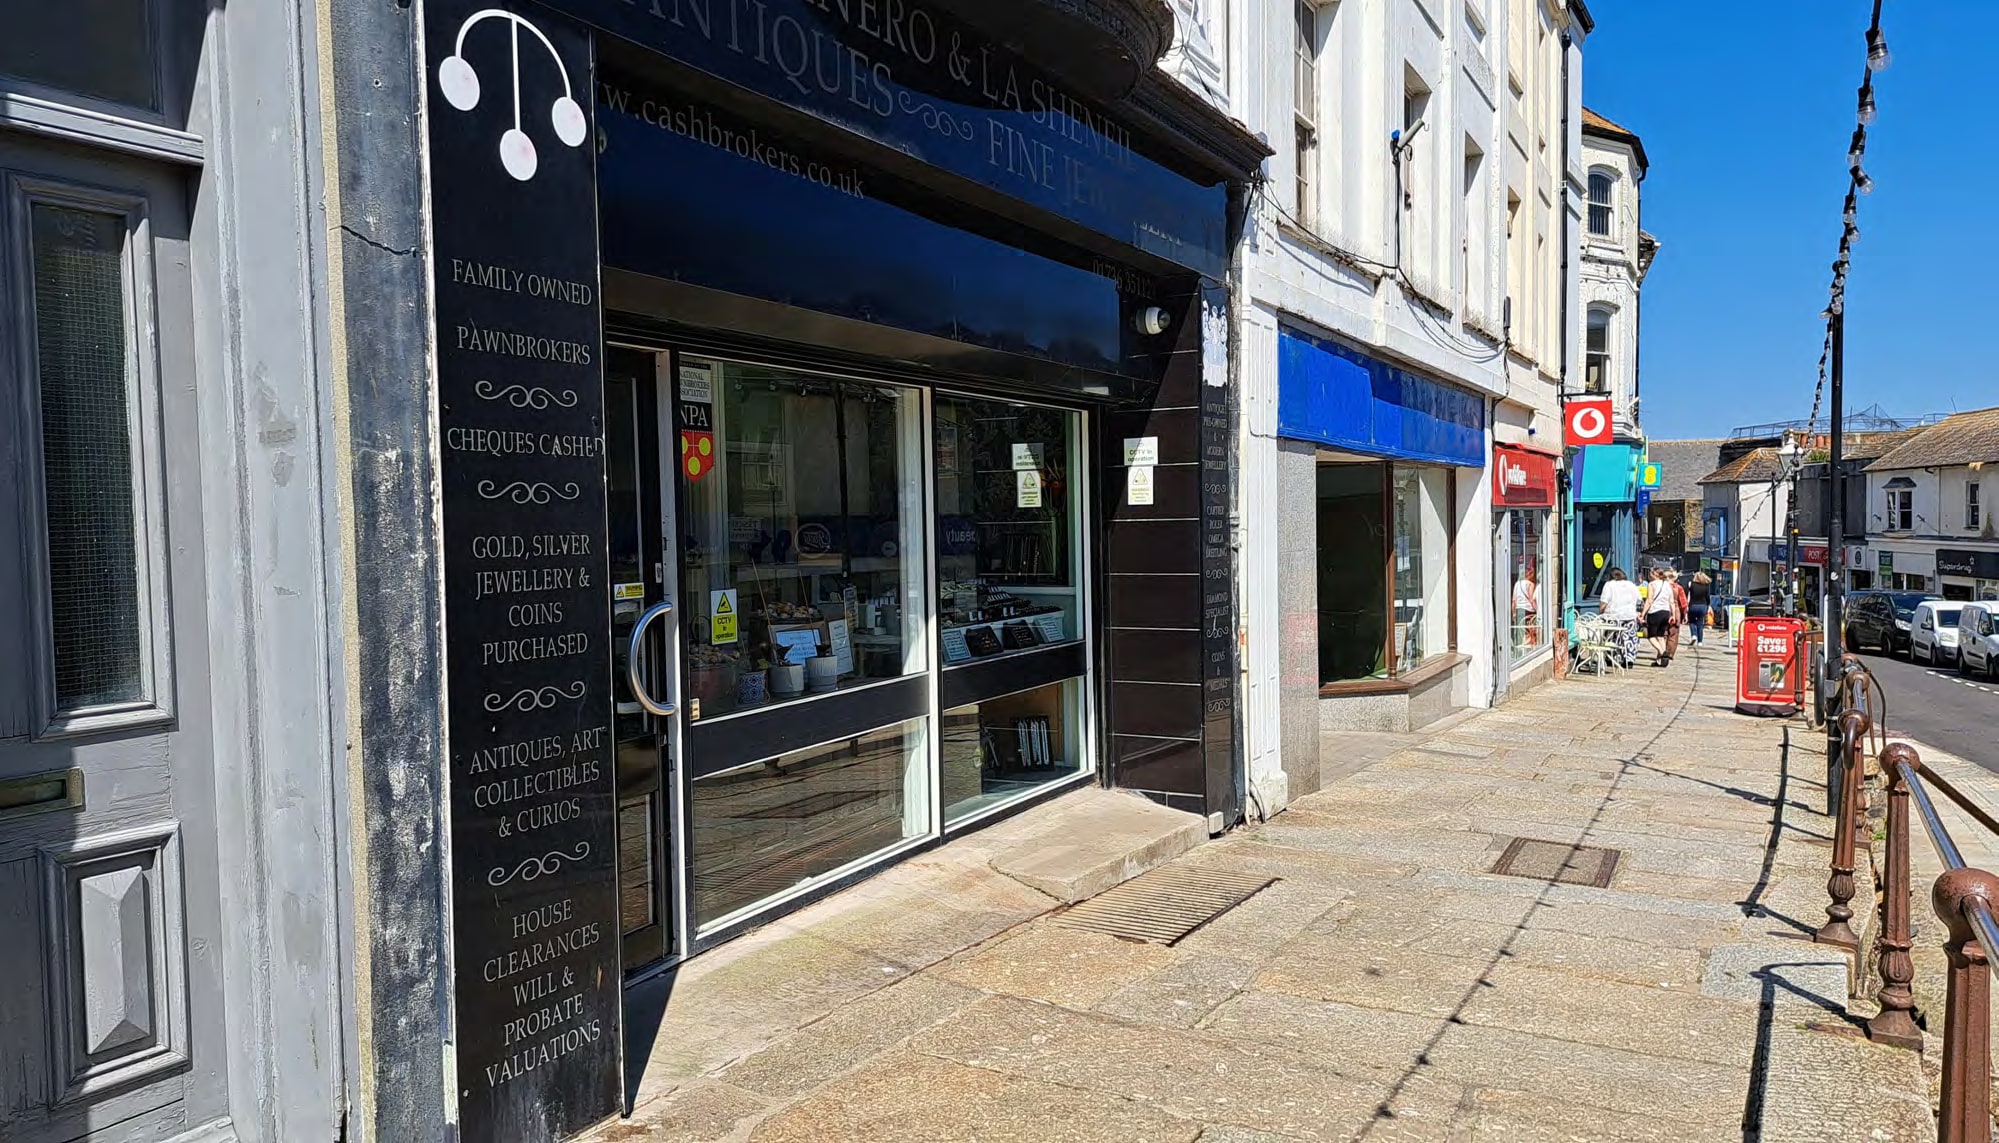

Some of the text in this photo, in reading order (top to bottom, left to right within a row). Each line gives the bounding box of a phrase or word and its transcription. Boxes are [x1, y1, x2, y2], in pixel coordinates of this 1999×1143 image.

[621, 0, 894, 118] NTIQUES
[948, 31, 973, 87] &
[982, 45, 1025, 113] LA
[986, 118, 1056, 191] FINE
[451, 258, 592, 306] FAMILY OWNED
[457, 325, 591, 366] PAWNBROKERS
[680, 404, 709, 427] NPA
[447, 427, 535, 457] CHEQUES
[472, 533, 591, 561] GOLD, SILVER
[1808, 549, 1820, 561] POST
[475, 566, 590, 600] JEWELLERY &
[508, 602, 563, 627] COINS
[717, 616, 732, 624] CCTV
[482, 632, 588, 665] PURCHASED
[1757, 635, 1781, 645] Save
[469, 727, 605, 775] ANTIQUES, ART
[473, 760, 601, 809] COLLECTIBLES
[498, 797, 581, 838] & CURIOS
[512, 899, 572, 939] HOUSE
[483, 922, 600, 983] CLEARANCES
[513, 965, 574, 1007] WILL &
[503, 993, 584, 1047] PROBATE
[485, 1019, 601, 1088] VALUATIONS
